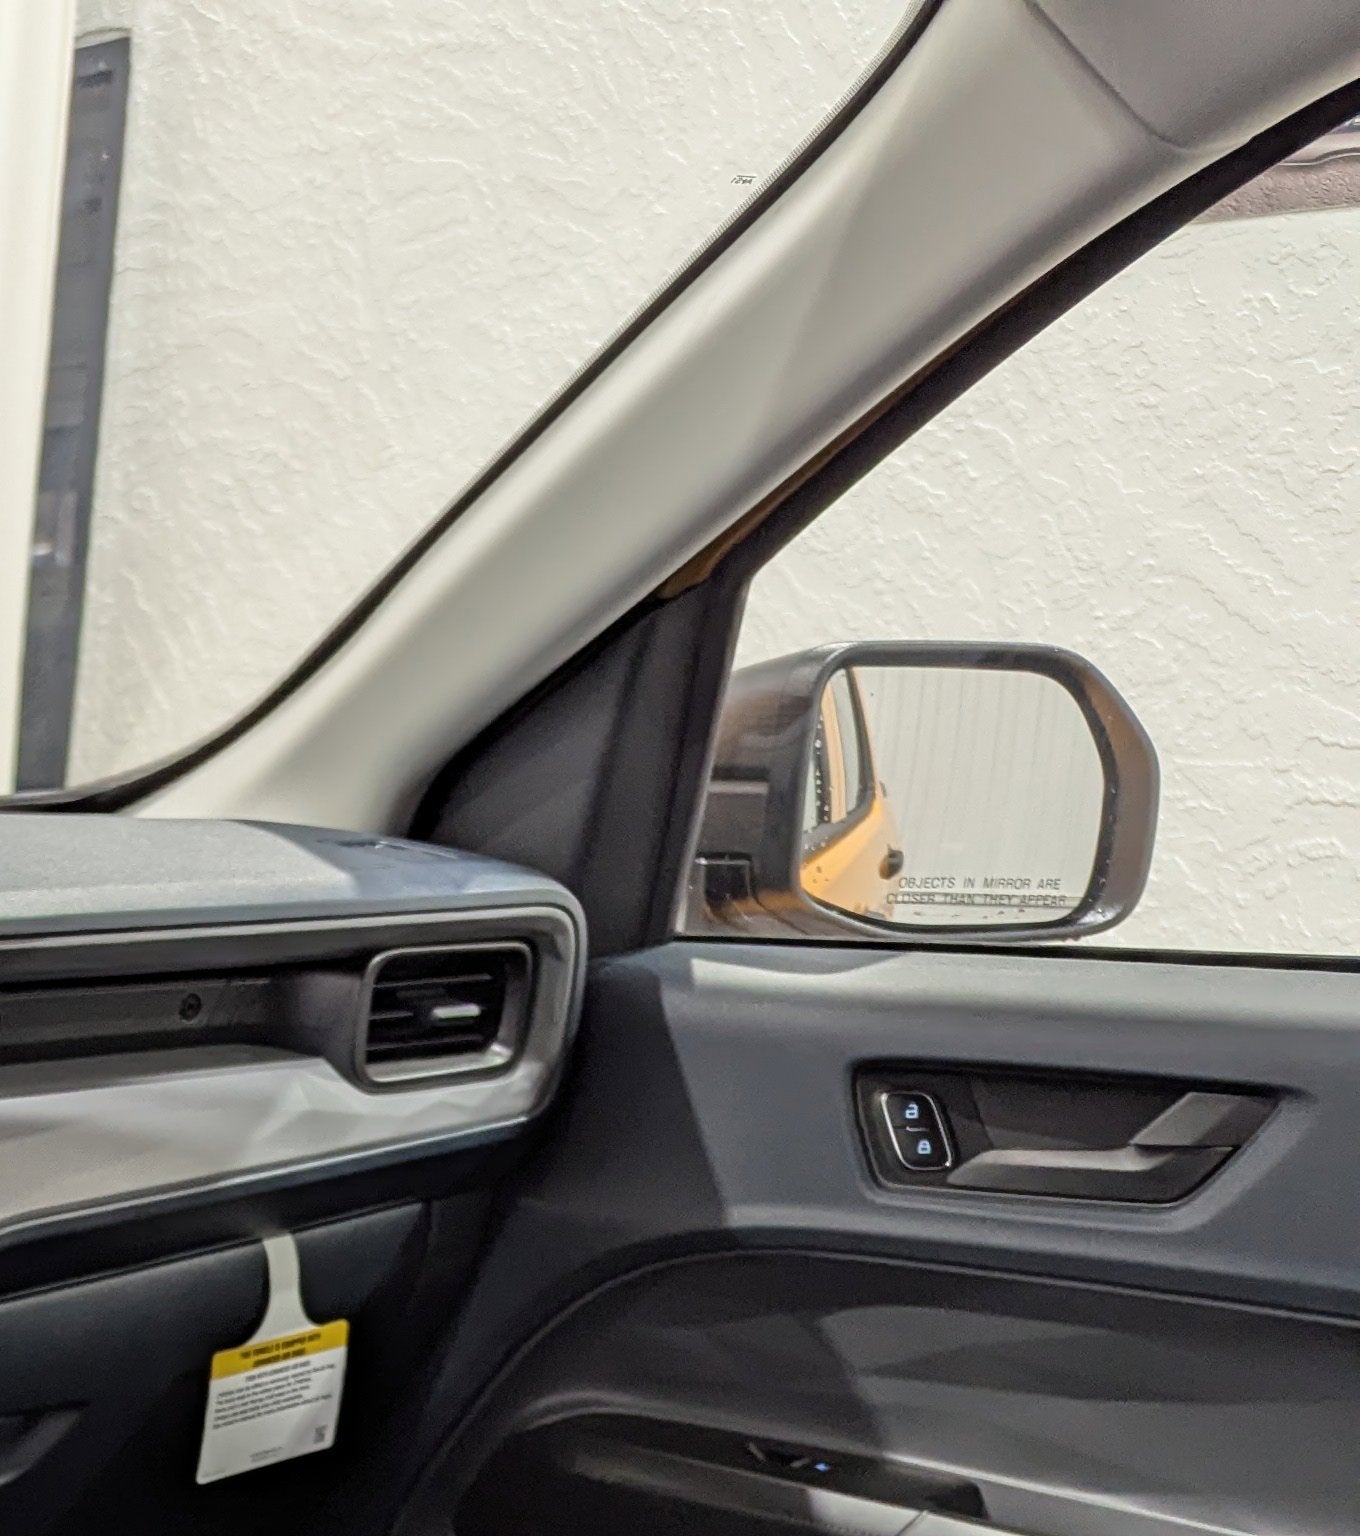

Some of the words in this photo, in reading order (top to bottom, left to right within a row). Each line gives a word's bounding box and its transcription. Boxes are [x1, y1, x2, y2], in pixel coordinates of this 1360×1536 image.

[899, 876, 956, 889] OBJECTS
[963, 876, 976, 889] IN
[983, 877, 1031, 890] MIRROR
[1037, 878, 1061, 890] ARE
[886, 892, 936, 905] CLOSER
[943, 893, 976, 905] THAN
[984, 894, 1013, 906] THEY
[1020, 894, 1068, 907] APPEAR
